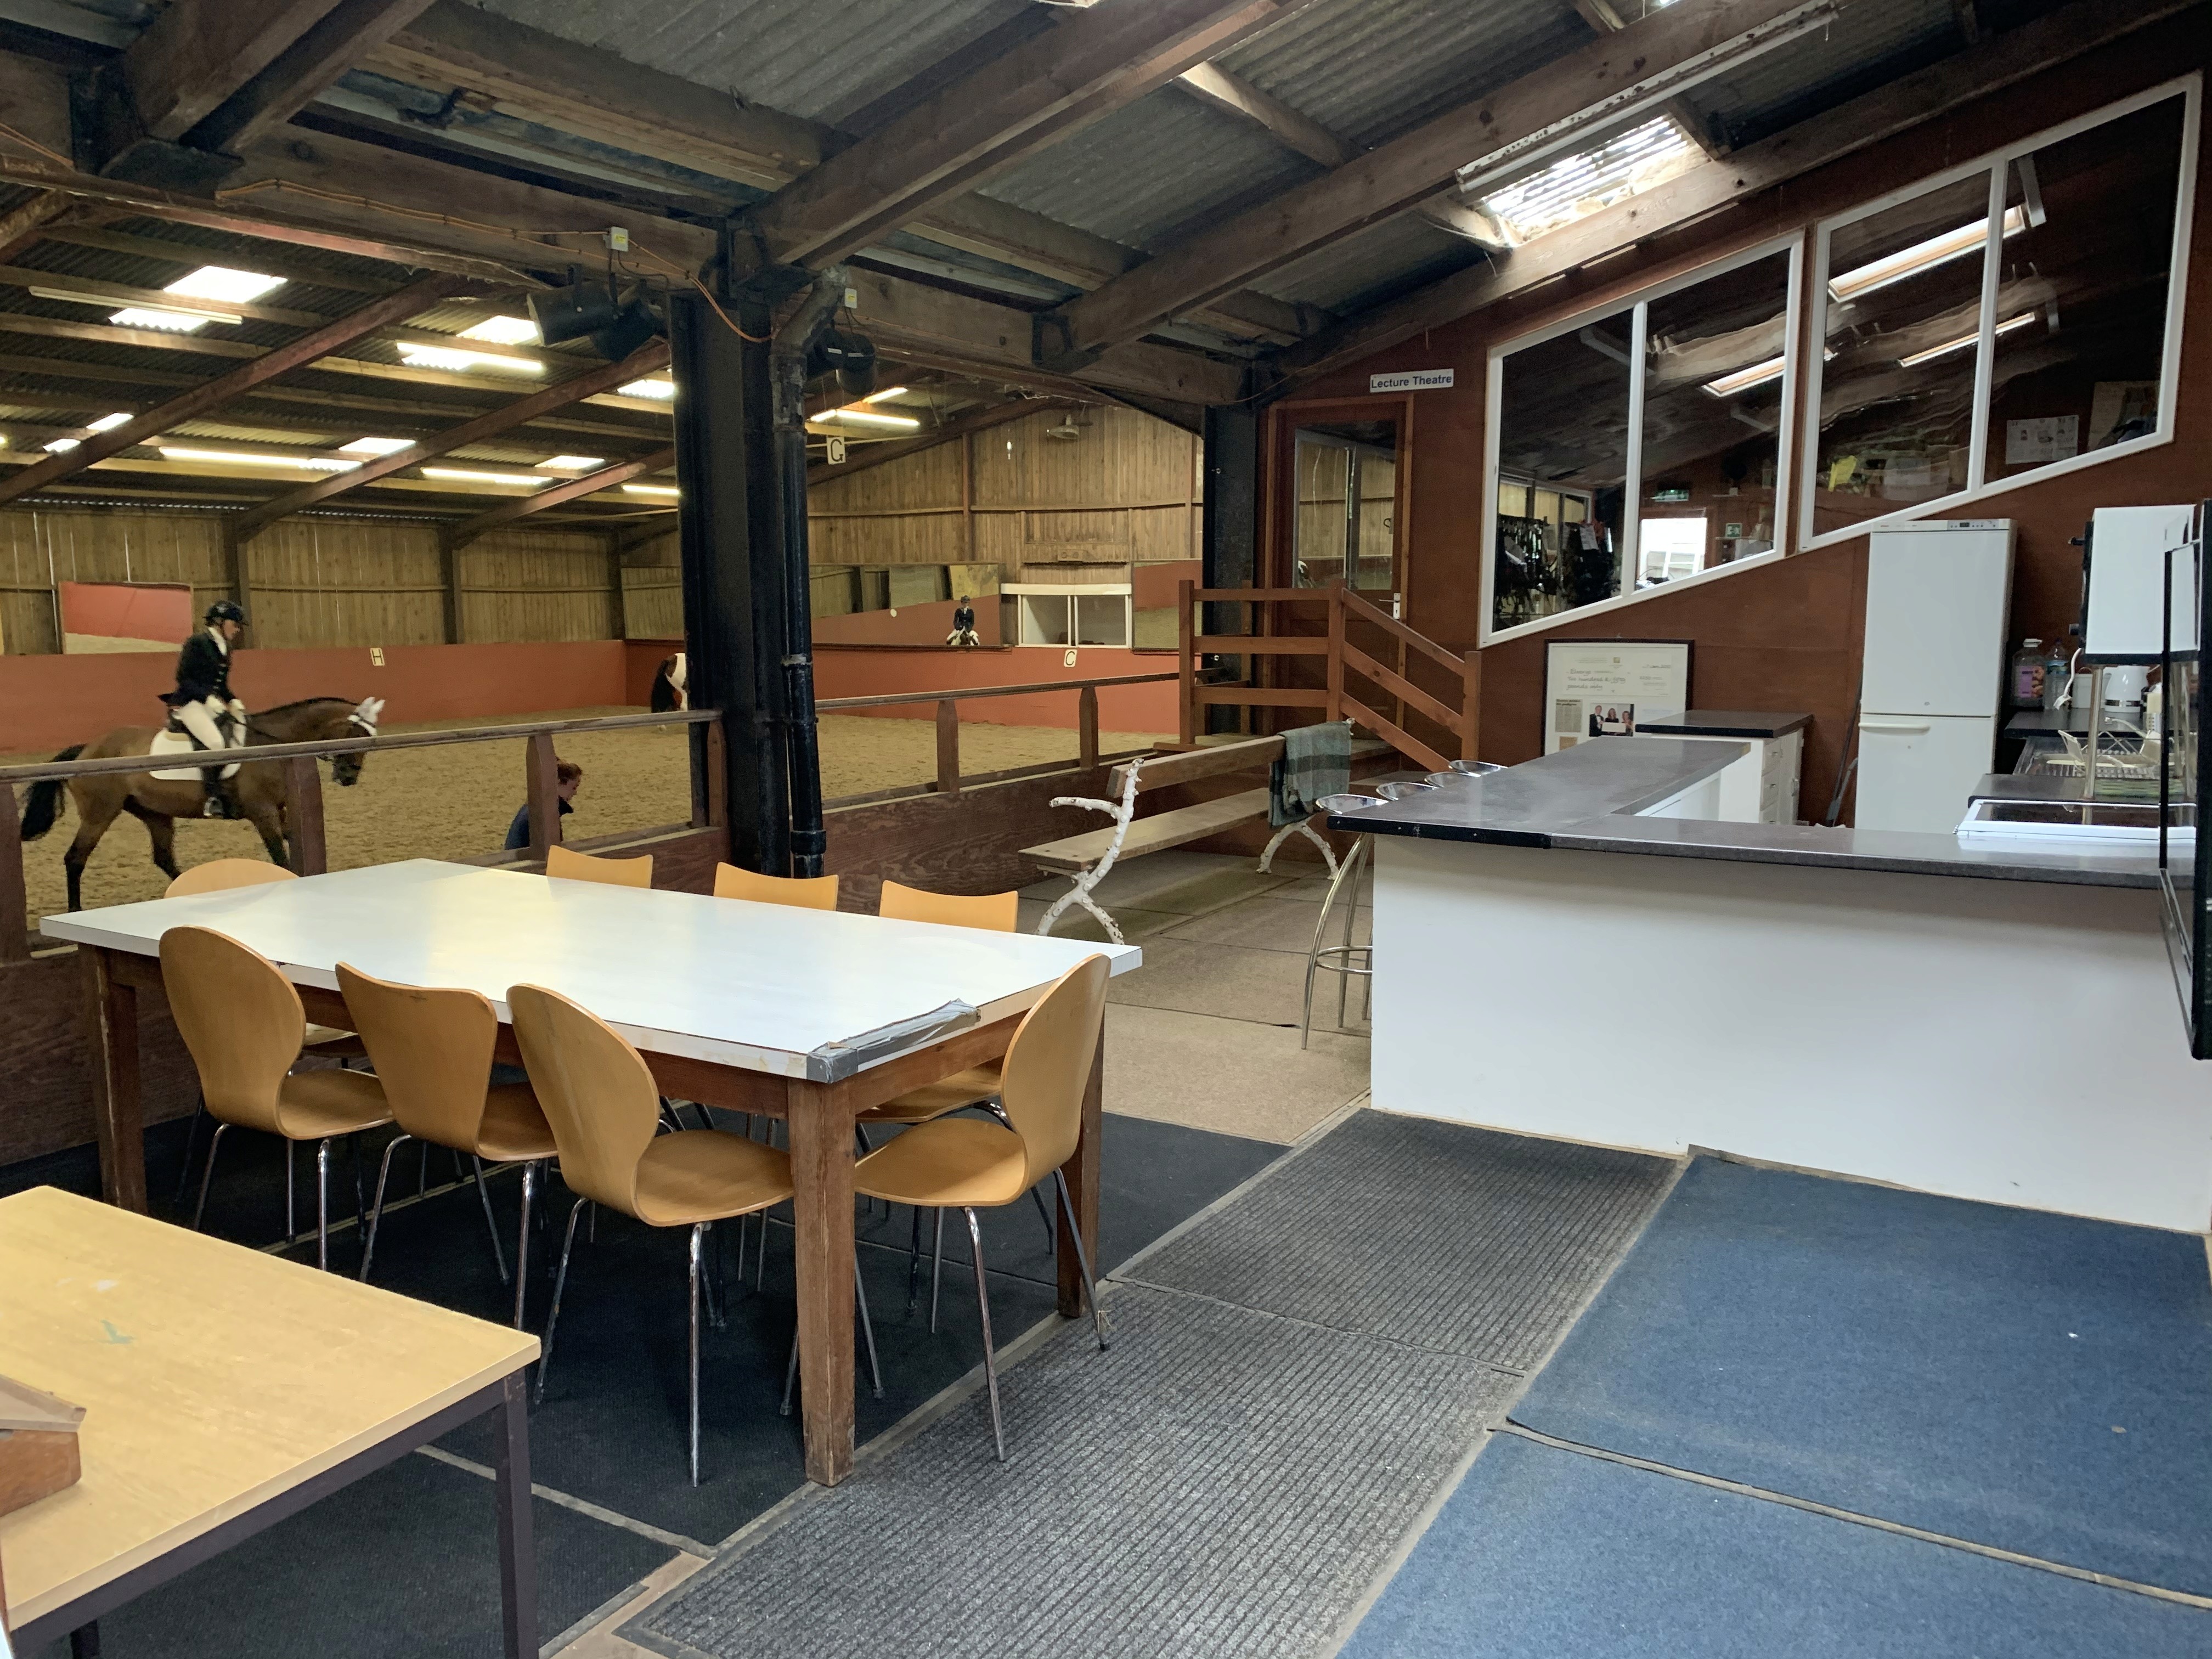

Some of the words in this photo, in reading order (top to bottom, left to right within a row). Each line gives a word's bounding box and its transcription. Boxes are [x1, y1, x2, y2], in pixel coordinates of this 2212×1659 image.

[1372, 379, 1409, 388] Lecture
[1413, 375, 1452, 385] Theatre
[831, 439, 843, 461] G
[372, 649, 383, 664] H
[1066, 651, 1075, 665] C
